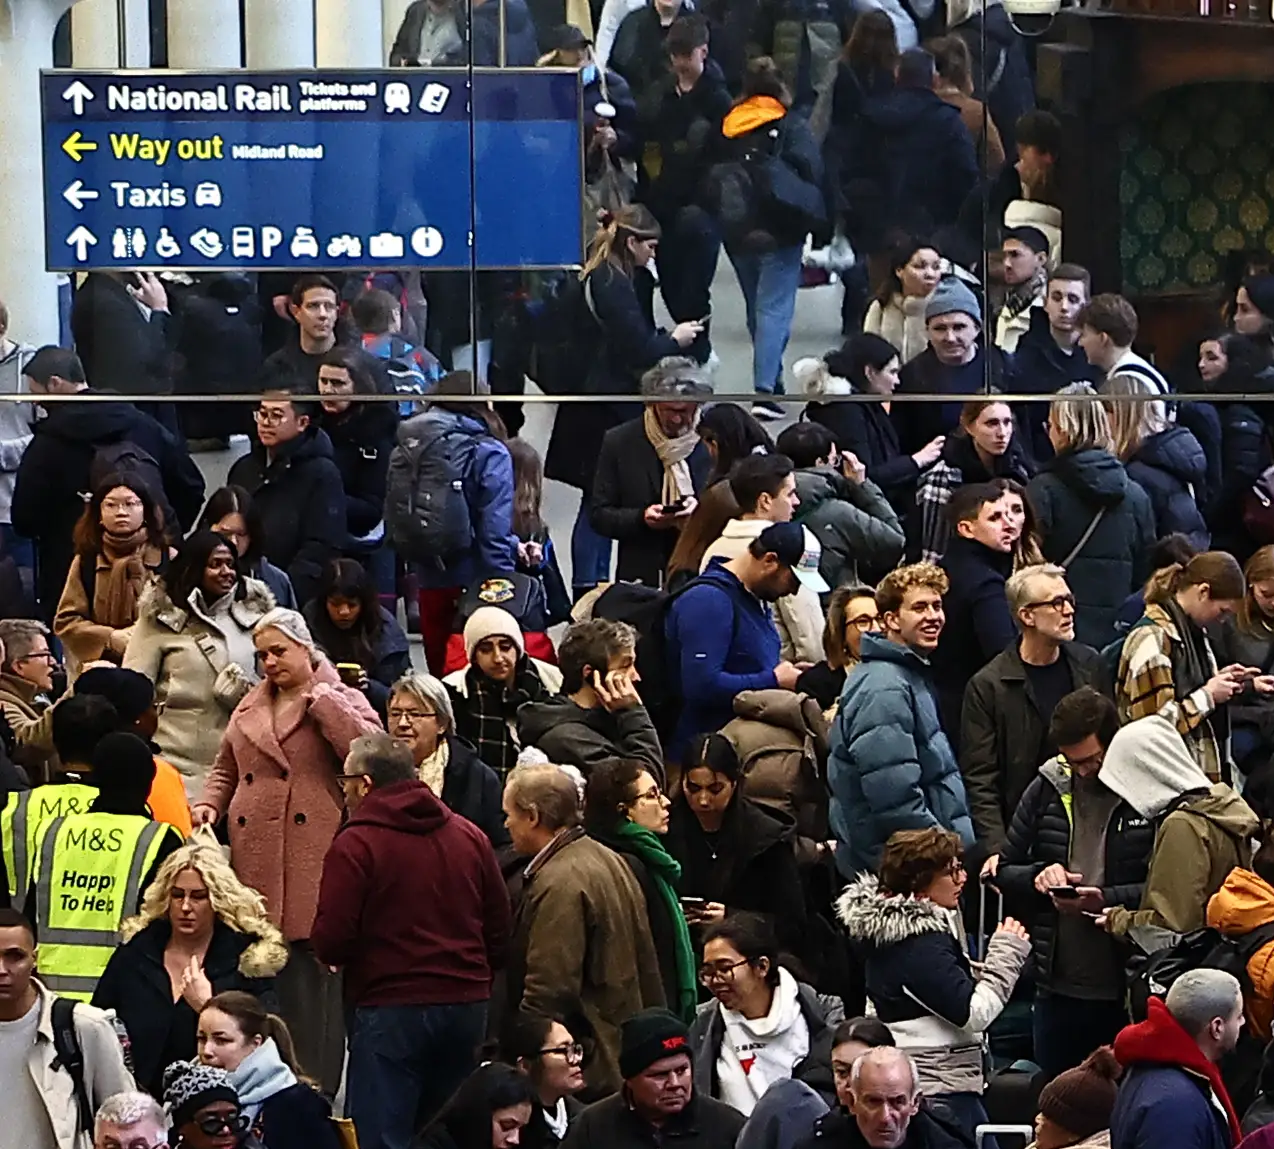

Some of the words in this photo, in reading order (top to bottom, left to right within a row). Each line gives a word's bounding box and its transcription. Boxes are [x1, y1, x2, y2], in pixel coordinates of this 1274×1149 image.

[108, 85, 229, 111] National
[235, 84, 292, 111] Rail
[299, 81, 349, 96] Tickets
[350, 81, 377, 96] and
[299, 97, 368, 114] platforms
[109, 133, 171, 166] Way
[177, 135, 224, 160] out
[231, 144, 287, 160] Midland
[287, 144, 324, 160] Road
[110, 181, 187, 207] Taxis
[39, 796, 95, 819] M&
[65, 828, 124, 852] M&S
[60, 894, 79, 911] To
